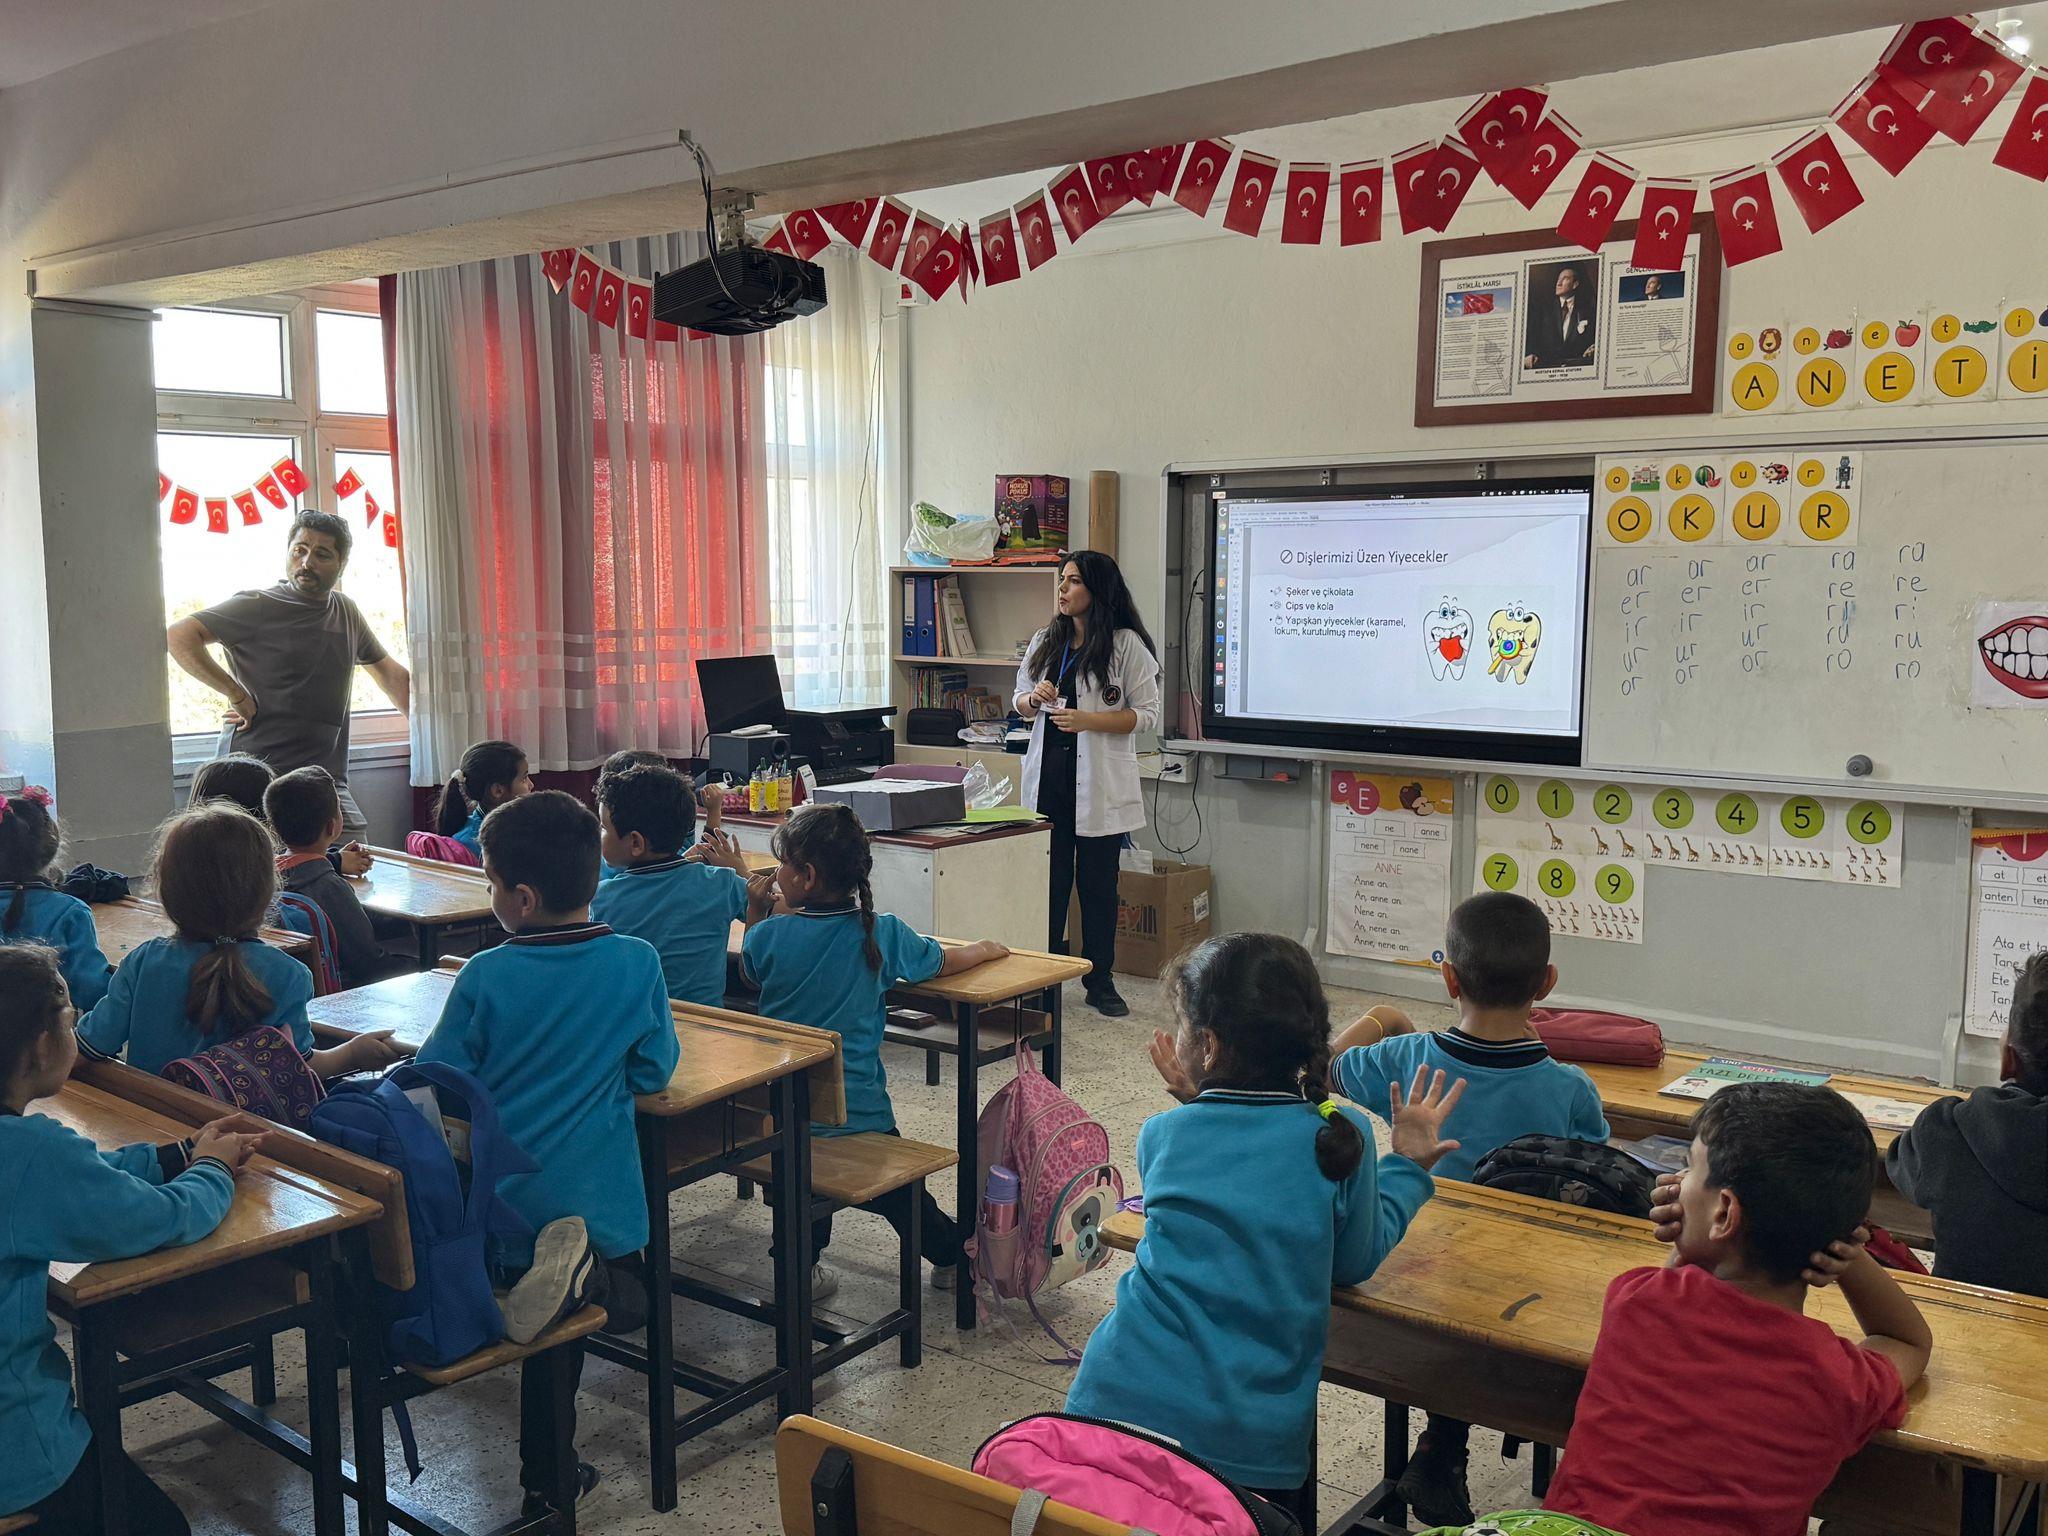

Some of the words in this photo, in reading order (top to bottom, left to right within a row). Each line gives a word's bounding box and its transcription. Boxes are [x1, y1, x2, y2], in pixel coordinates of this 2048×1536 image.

[1736, 341, 1745, 351] a
[1802, 337, 1811, 346] n
[1871, 331, 1880, 340] e
[1942, 321, 1949, 333] t
[1745, 375, 1765, 399] A
[1810, 369, 1832, 396] N
[1882, 365, 1898, 390] E
[1951, 358, 1970, 384] T
[1613, 475, 1621, 484] o
[1675, 469, 1683, 485] k
[1739, 470, 1748, 480] u
[1807, 468, 1814, 478] r
[1617, 508, 1640, 532] O
[1684, 507, 1700, 531] K
[1747, 504, 1766, 529] U
[1816, 503, 1832, 529] R
[1296, 551, 1354, 566] Dişlerimizi
[1356, 549, 1385, 564] Üzen
[1388, 550, 1449, 566] Yiyecekler
[1285, 587, 1310, 597] Şeker
[1322, 587, 1354, 598] çikolata
[1285, 602, 1304, 612] Cips
[1316, 601, 1334, 611] kola
[1285, 616, 1322, 628] Yapışkan
[1323, 617, 1365, 629] yiyecekler
[1366, 617, 1407, 629] (karamel,
[1274, 627, 1301, 638] lokum,
[1302, 627, 1347, 639] kurutulmuş
[1348, 628, 1379, 639] meyve)
[1337, 782, 1348, 794] e
[1358, 787, 1371, 810] E
[1494, 783, 1509, 805] 0
[1551, 789, 1558, 810] 1
[1605, 794, 1621, 816] 2
[1666, 798, 1680, 820] 3
[1727, 802, 1746, 826] 4
[1793, 805, 1811, 829] 5
[1860, 811, 1876, 835] 6
[1420, 828, 1440, 837] anne
[1360, 841, 1379, 850] nene
[1374, 861, 1403, 875] ANNE
[1354, 875, 1375, 887] Anne
[1494, 862, 1507, 884] 7
[1550, 868, 1563, 889] 8
[1607, 873, 1621, 894] 9
[1993, 869, 2006, 880] at
[2036, 873, 2047, 884] et
[1370, 894, 1389, 904] anne
[1984, 891, 2014, 903] anten
[1354, 904, 1375, 917] Nene
[1369, 925, 1388, 934] nene
[1353, 935, 1375, 948] Anne,
[1378, 940, 1396, 950] nene
[1993, 935, 2014, 949] Ata
[2019, 940, 2032, 951] et
[1991, 972, 2010, 986] Ete
[1698, 1066, 1733, 1078] YAZI
